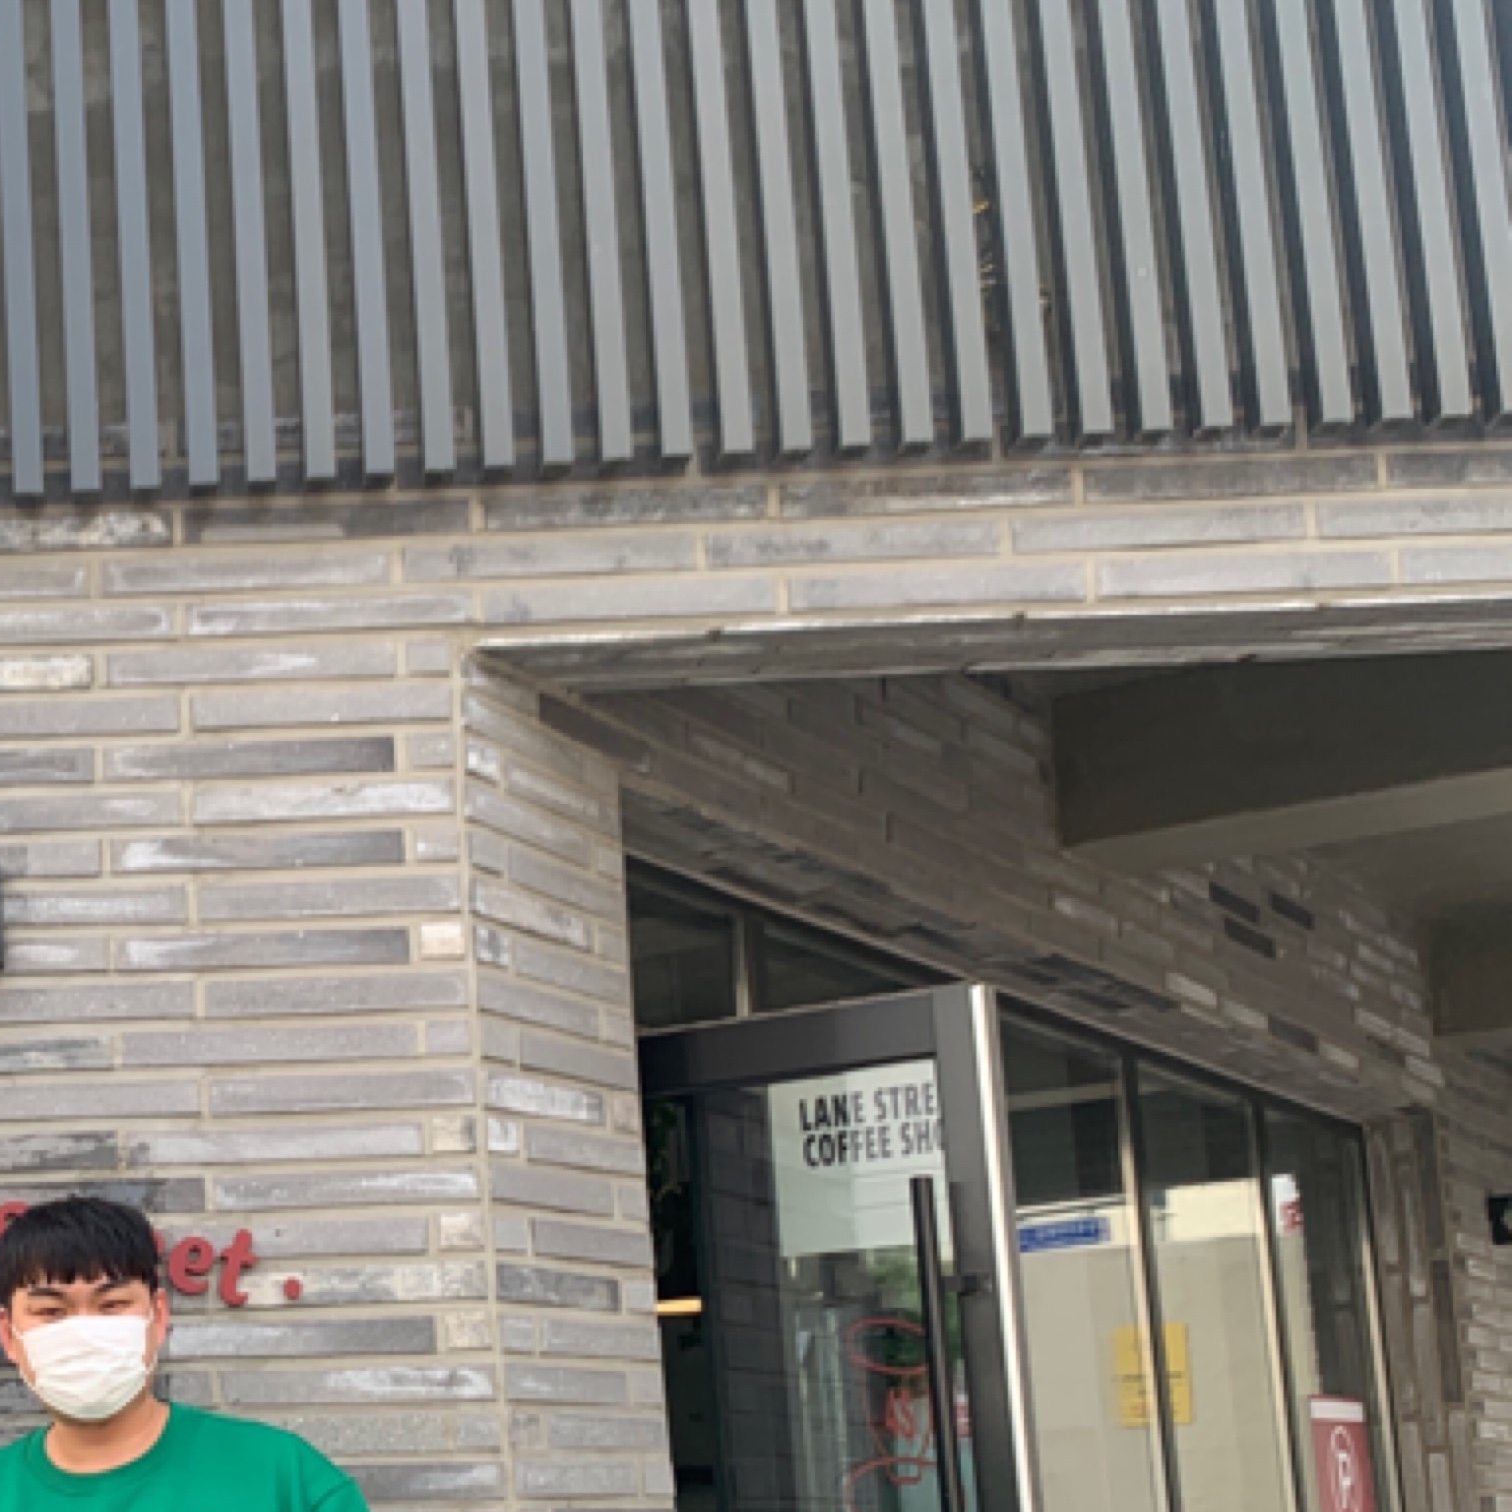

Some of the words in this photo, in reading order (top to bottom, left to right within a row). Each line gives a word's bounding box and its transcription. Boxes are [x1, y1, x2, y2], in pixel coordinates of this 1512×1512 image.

[799, 1089, 864, 1132] LANE
[874, 1083, 935, 1122] STRE
[803, 1125, 891, 1167] COFFEE
